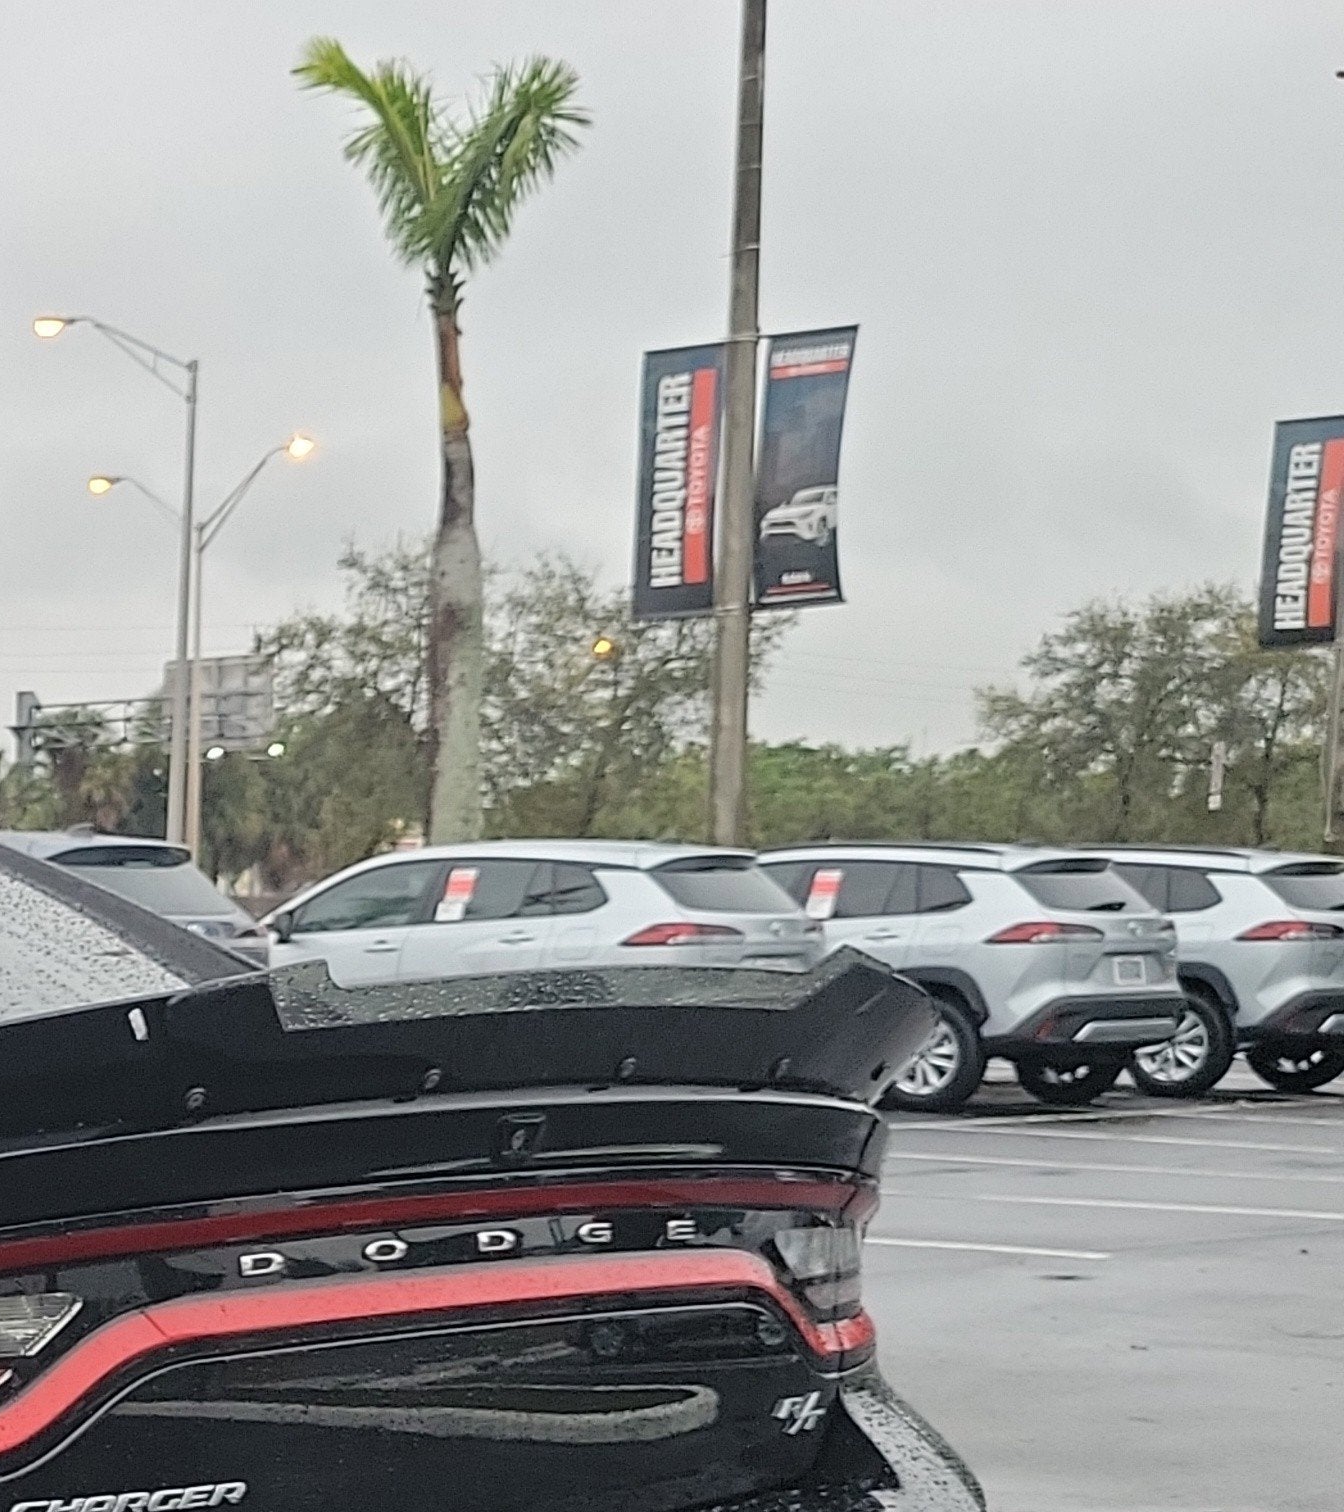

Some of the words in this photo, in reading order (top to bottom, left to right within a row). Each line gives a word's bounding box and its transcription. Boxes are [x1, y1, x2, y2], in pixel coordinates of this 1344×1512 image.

[650, 371, 693, 588] HEADQUARTER
[1274, 441, 1322, 630] HEADQUARTER
[240, 1219, 698, 1277] DODGE
